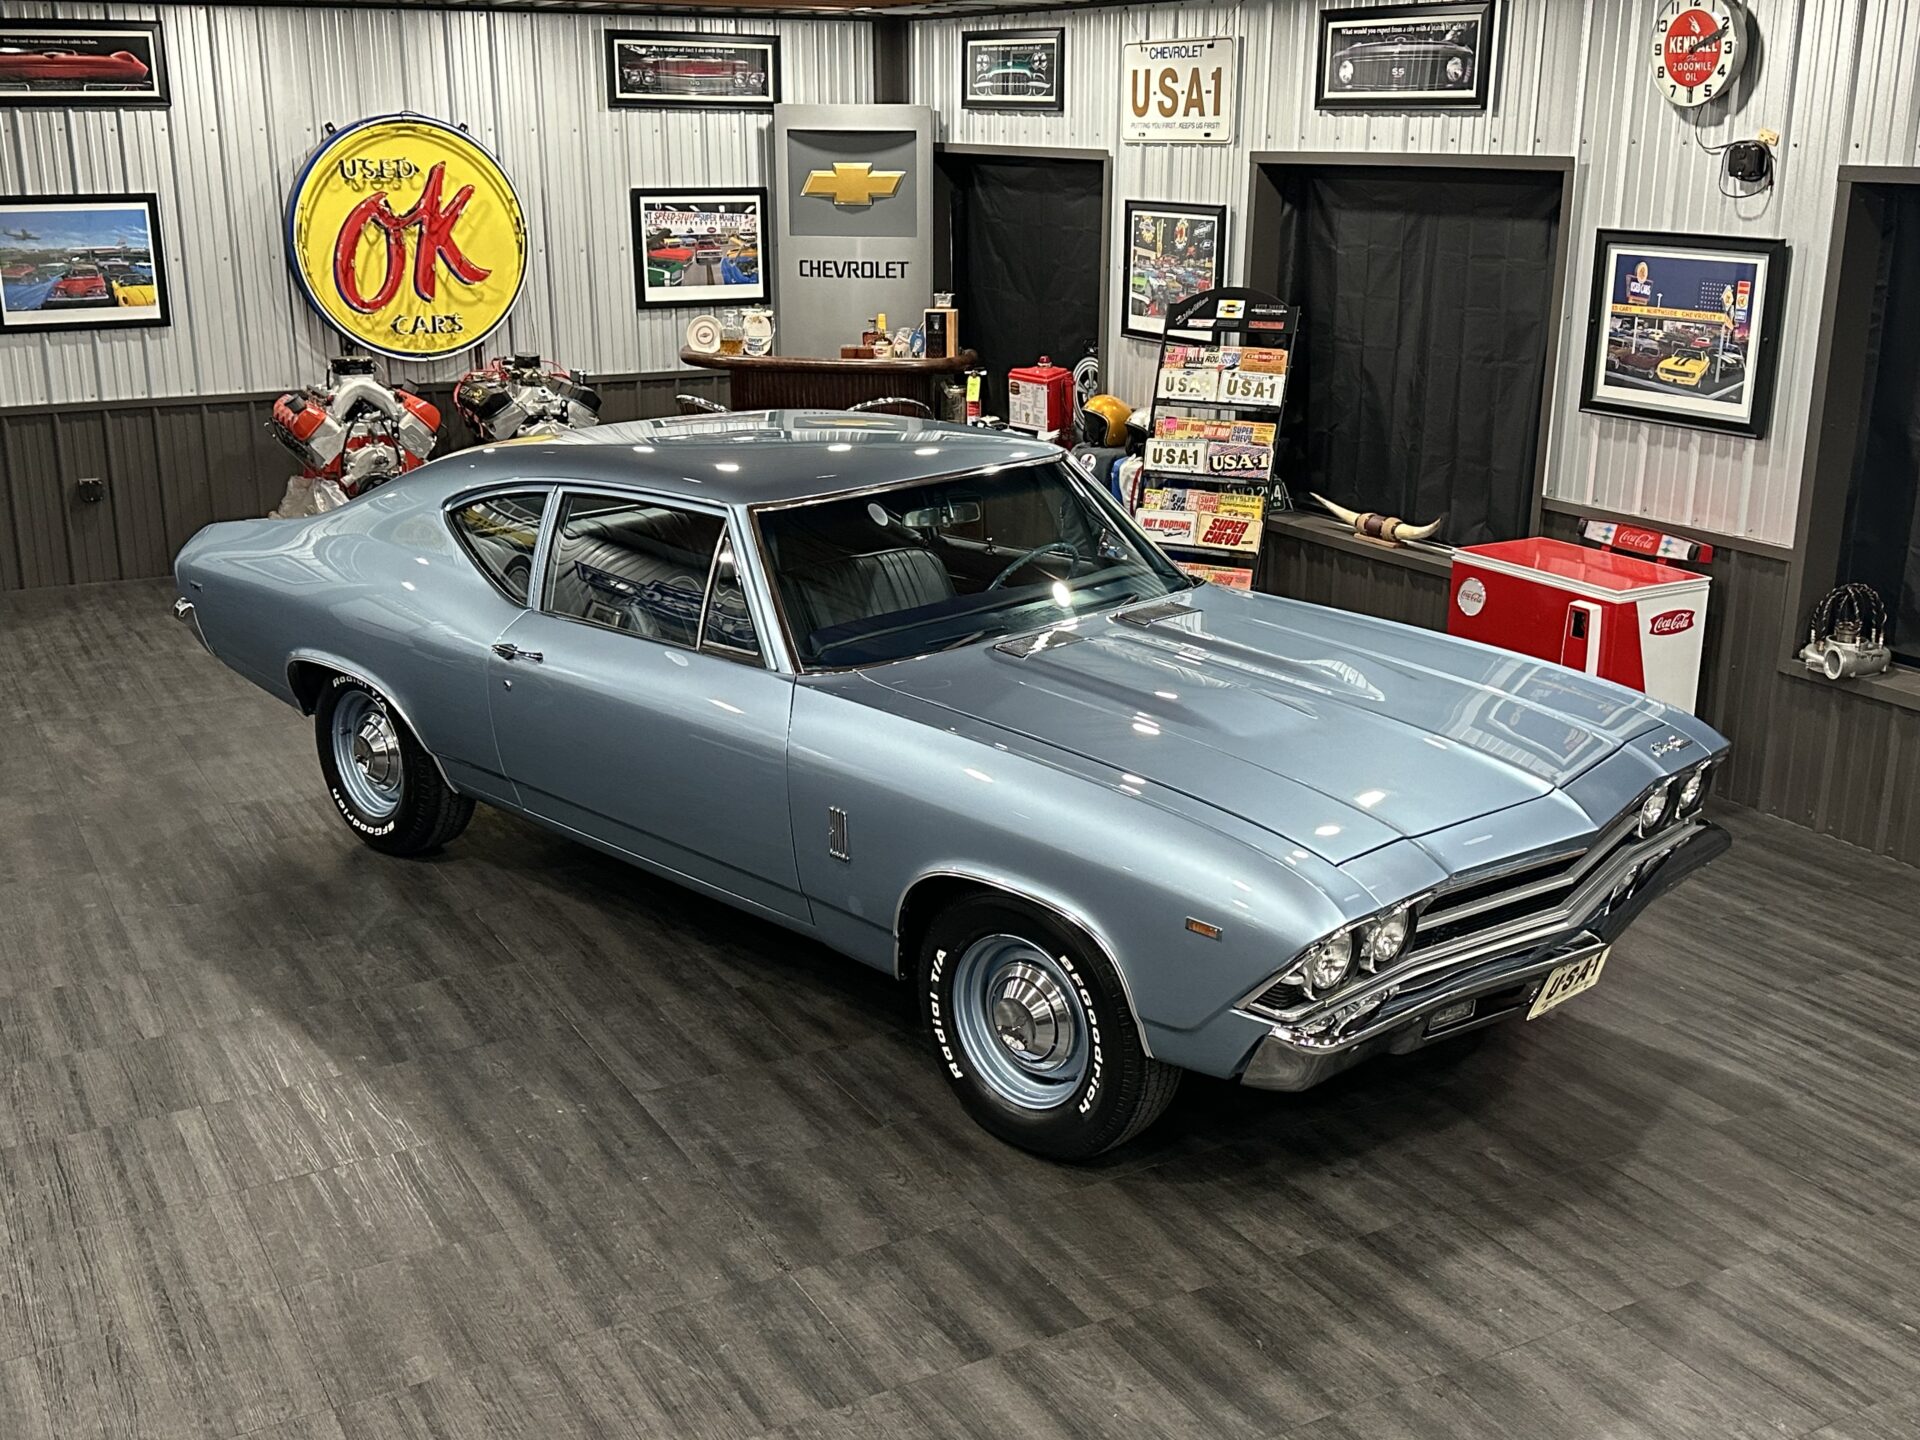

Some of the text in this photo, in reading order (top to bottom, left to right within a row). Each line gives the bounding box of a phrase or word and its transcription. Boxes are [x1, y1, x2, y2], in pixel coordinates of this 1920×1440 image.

[1722, 16, 1730, 30] 2
[1150, 44, 1204, 59] CHEVROLET
[1655, 44, 1662, 56] 9
[1724, 41, 1732, 54] 3
[1657, 66, 1664, 78] 8
[1685, 72, 1697, 81] OIL
[1717, 64, 1726, 77] 4
[1670, 85, 1676, 98] 7
[1704, 84, 1712, 97] 5
[339, 159, 415, 179] USED
[334, 161, 492, 314] OK
[799, 260, 909, 278] CHEVROLET
[1646, 308, 1678, 317] NORTHSIDE
[1682, 312, 1717, 320] CHEVROLET
[392, 314, 464, 335] CARS
[1233, 426, 1253, 434] SUPER
[1210, 518, 1249, 534] SUPER
[1202, 531, 1243, 546] CHEVY
[1619, 530, 1655, 548] Coca-Cola
[1654, 612, 1691, 633] Coca-Cola
[930, 949, 963, 1079] Radial T/A
[1059, 955, 1103, 1114] BFGoodrich
